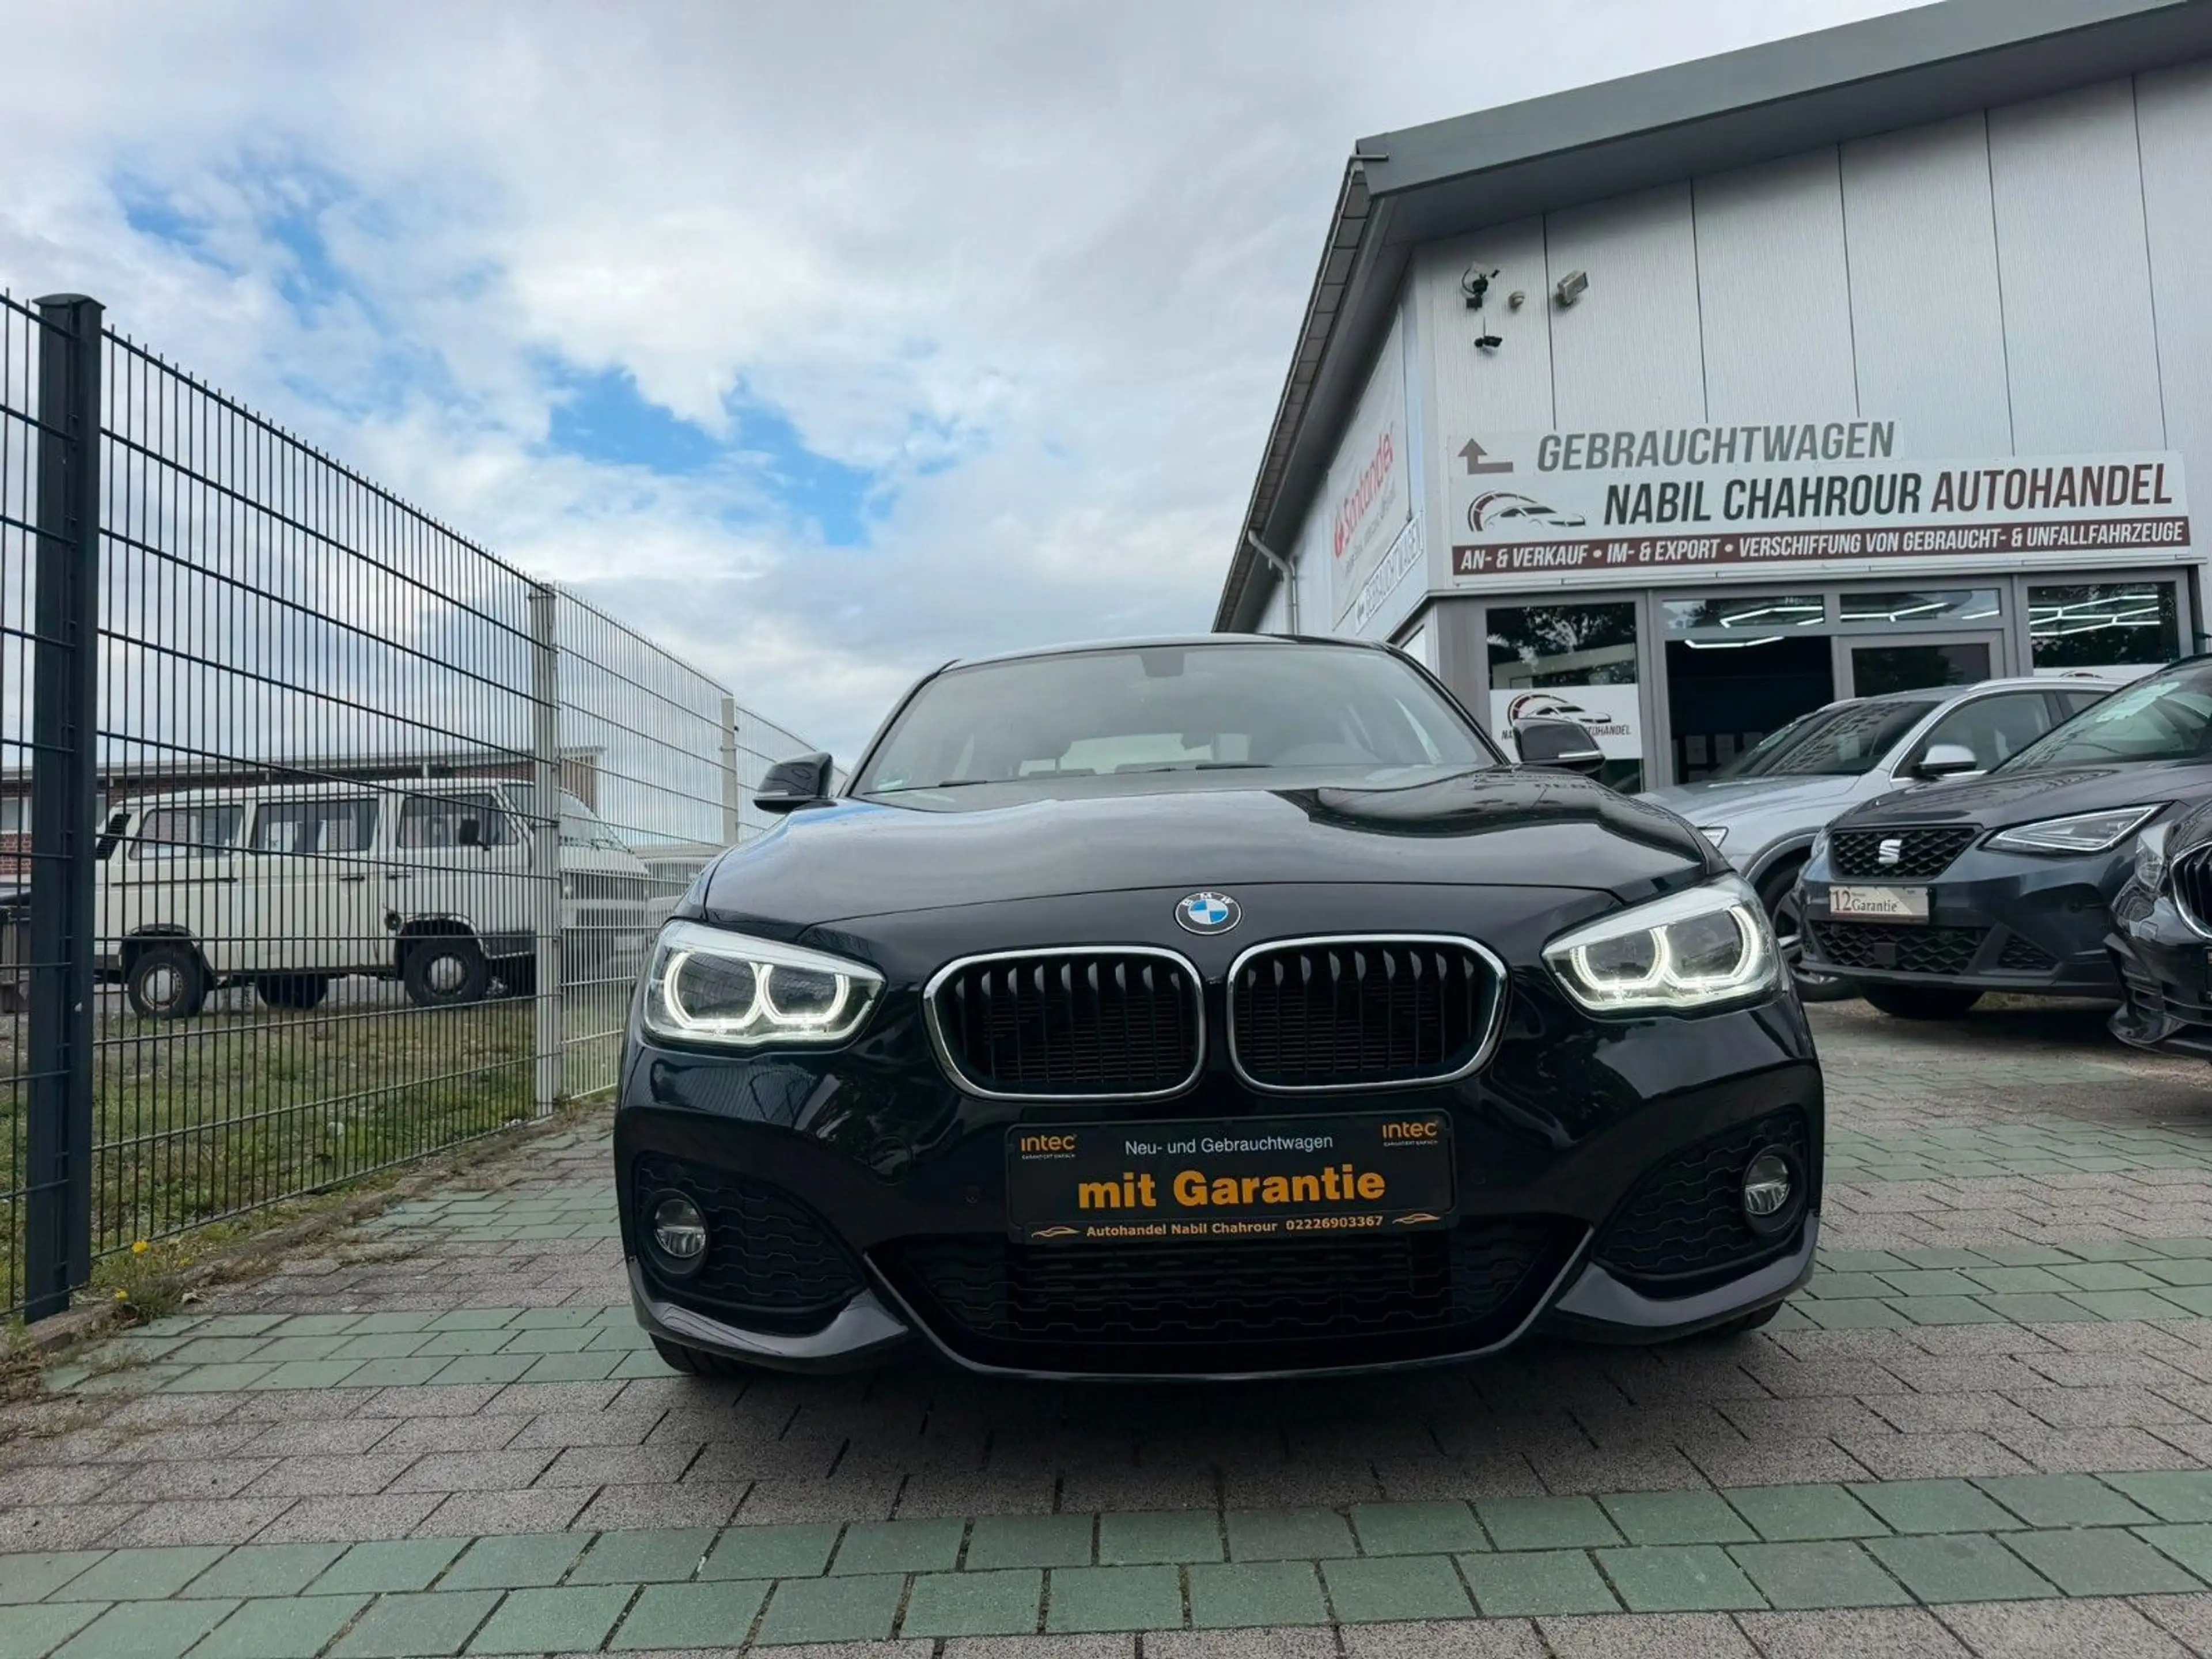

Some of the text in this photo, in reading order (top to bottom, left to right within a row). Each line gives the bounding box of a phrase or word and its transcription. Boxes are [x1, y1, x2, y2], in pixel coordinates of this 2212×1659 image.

[1537, 421, 1895, 472] GEBRAUCHTWAGEN
[1604, 463, 2172, 525] NABIL CHAHROUR AUTOHANDEL
[1461, 521, 2184, 570] AN- & VERKAUF IM- & EXPORT VERSCHIFFUNG VON GEBRAUCHT- & UNFALLFAHRZEUGE
[1587, 724, 1632, 737] TOHANDEL
[1832, 891, 1898, 912] 12 Garantie
[1382, 1121, 1438, 1138] intec
[1021, 1134, 1075, 1151] intec
[1125, 1135, 1333, 1155] Neu- und Gebrauchtwagen
[1078, 1164, 1385, 1209] mit Garantie
[1086, 1216, 1382, 1237] Autohandel Nabil Chahrour 02226903367
